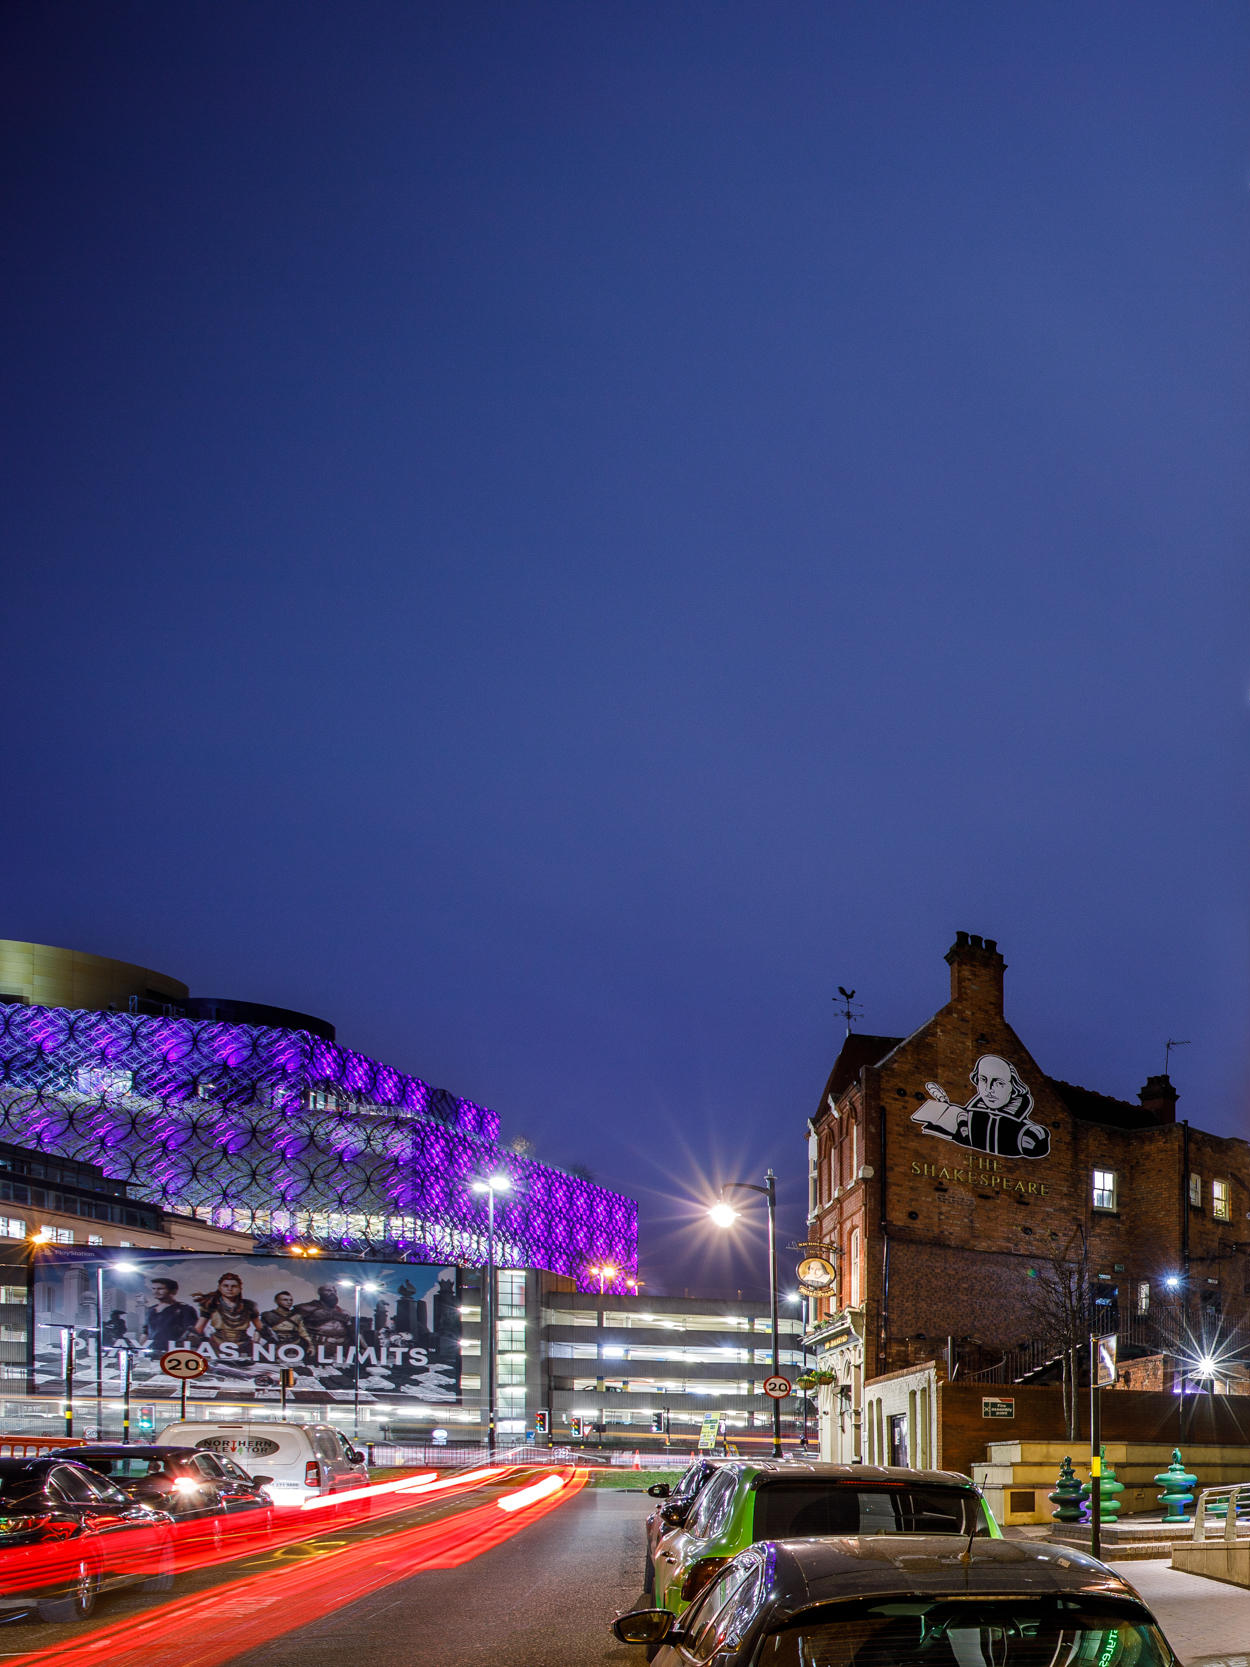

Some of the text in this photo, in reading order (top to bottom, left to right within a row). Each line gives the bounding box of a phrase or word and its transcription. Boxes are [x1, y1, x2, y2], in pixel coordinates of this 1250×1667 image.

[967, 1156, 1002, 1172] THE
[911, 1161, 1050, 1196] SHAKESPEARE
[168, 1340, 240, 1360] HAS
[252, 1343, 305, 1363] NO
[167, 1358, 200, 1371] 20
[768, 1382, 788, 1392] 20
